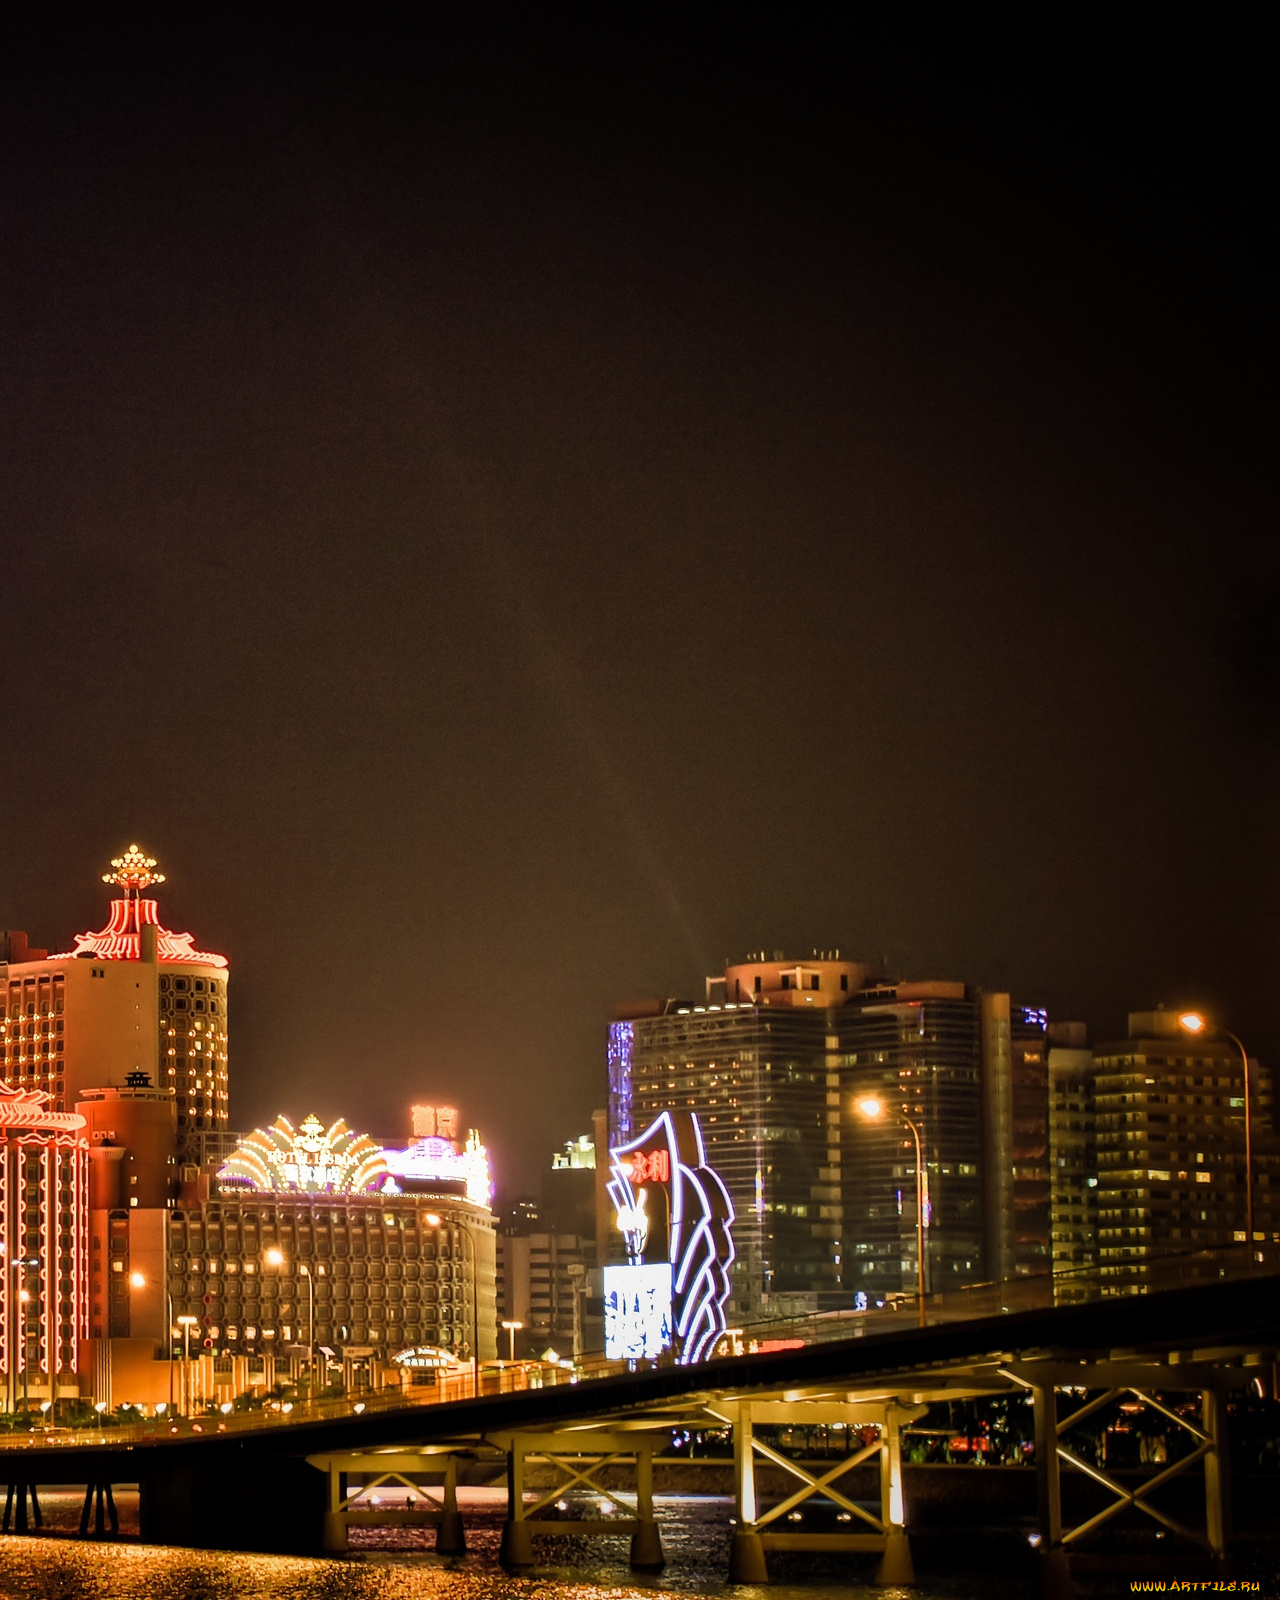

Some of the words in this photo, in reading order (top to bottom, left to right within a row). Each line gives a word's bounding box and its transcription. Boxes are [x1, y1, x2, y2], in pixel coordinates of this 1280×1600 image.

[267, 1151, 312, 1166] HOTEL
[314, 1151, 360, 1166] LISBOA
[629, 1149, 669, 1184] 永利
